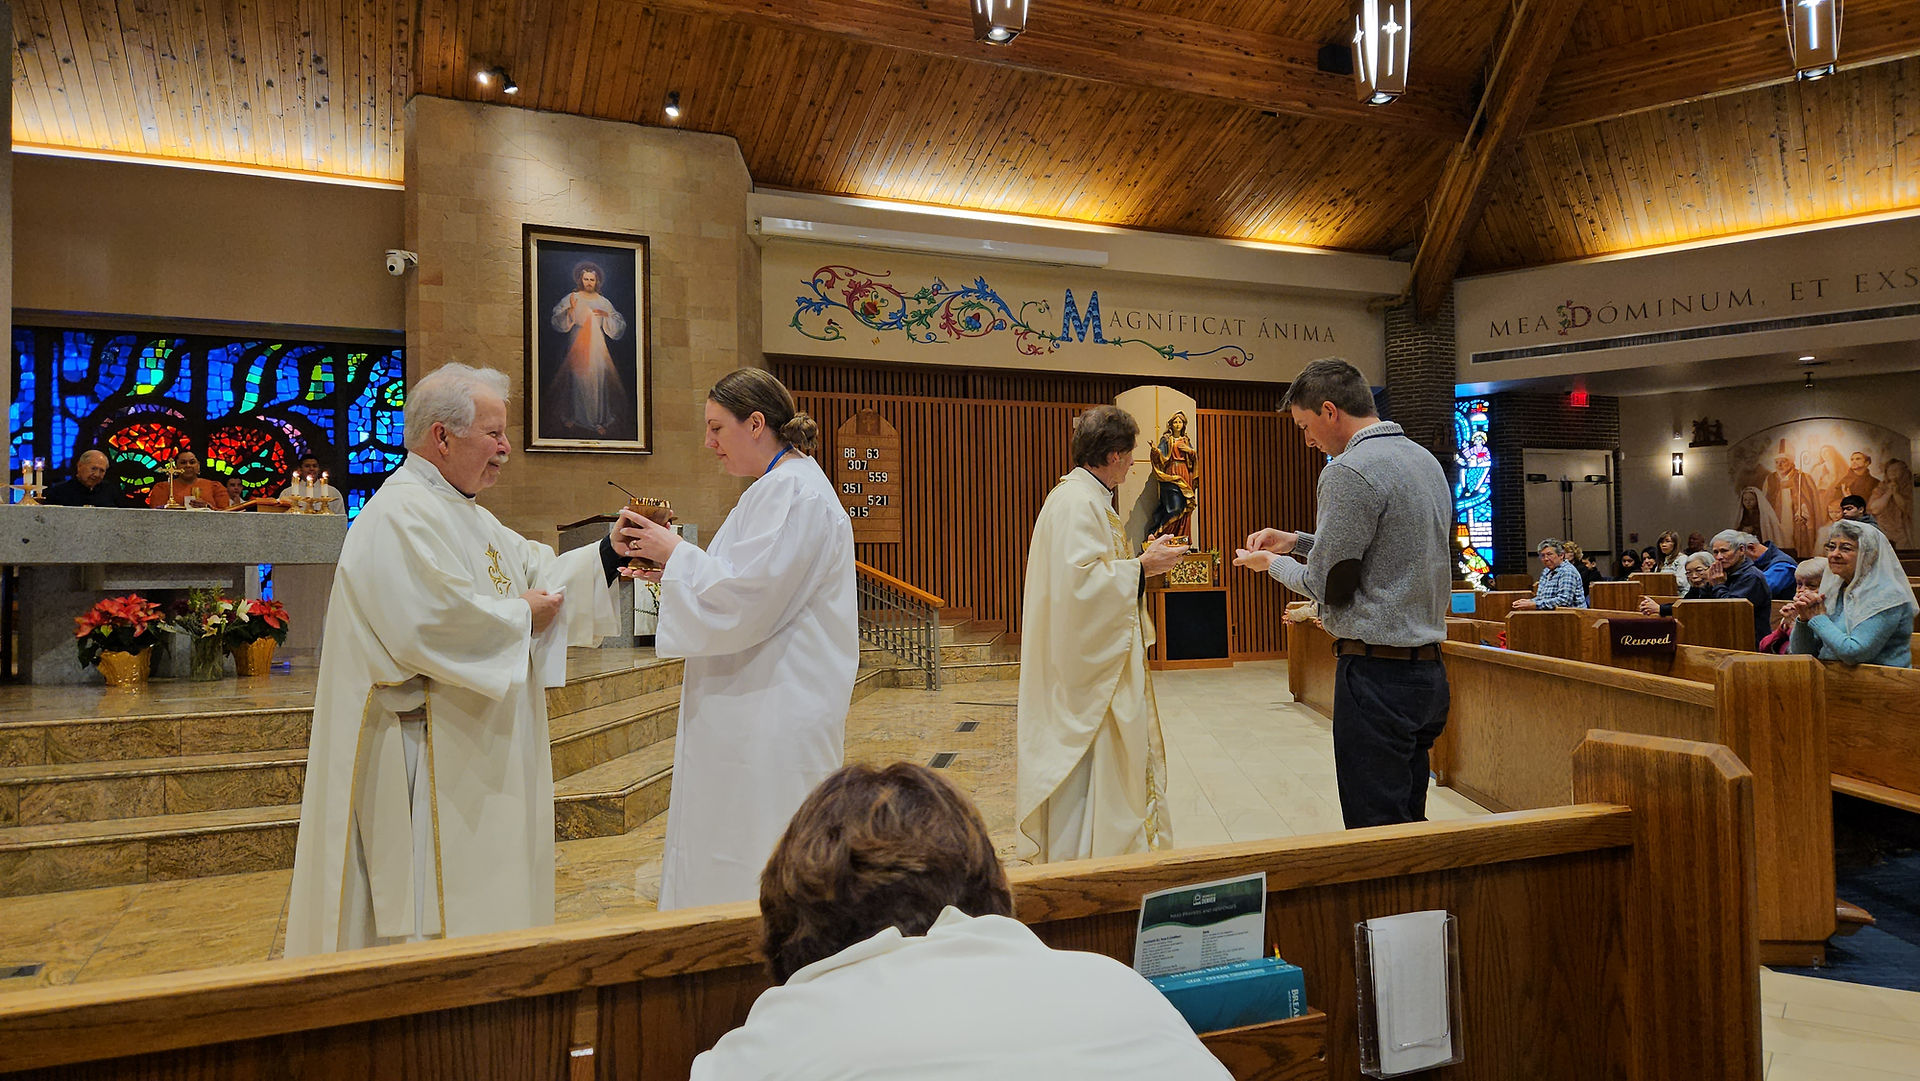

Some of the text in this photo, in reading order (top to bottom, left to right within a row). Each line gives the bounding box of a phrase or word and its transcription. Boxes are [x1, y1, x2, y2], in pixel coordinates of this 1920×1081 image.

[1488, 314, 1549, 339] MEA
[1791, 278, 1829, 301] ET
[1855, 266, 1919, 294] EXS
[1258, 316, 1336, 343] ÁNIMA
[844, 448, 879, 459] BB 63
[848, 460, 867, 470] 307
[868, 472, 888, 482] 559
[843, 483, 861, 493] 351
[867, 495, 887, 505] 521
[849, 506, 869, 517] 615
[1620, 633, 1672, 646] Reserved
